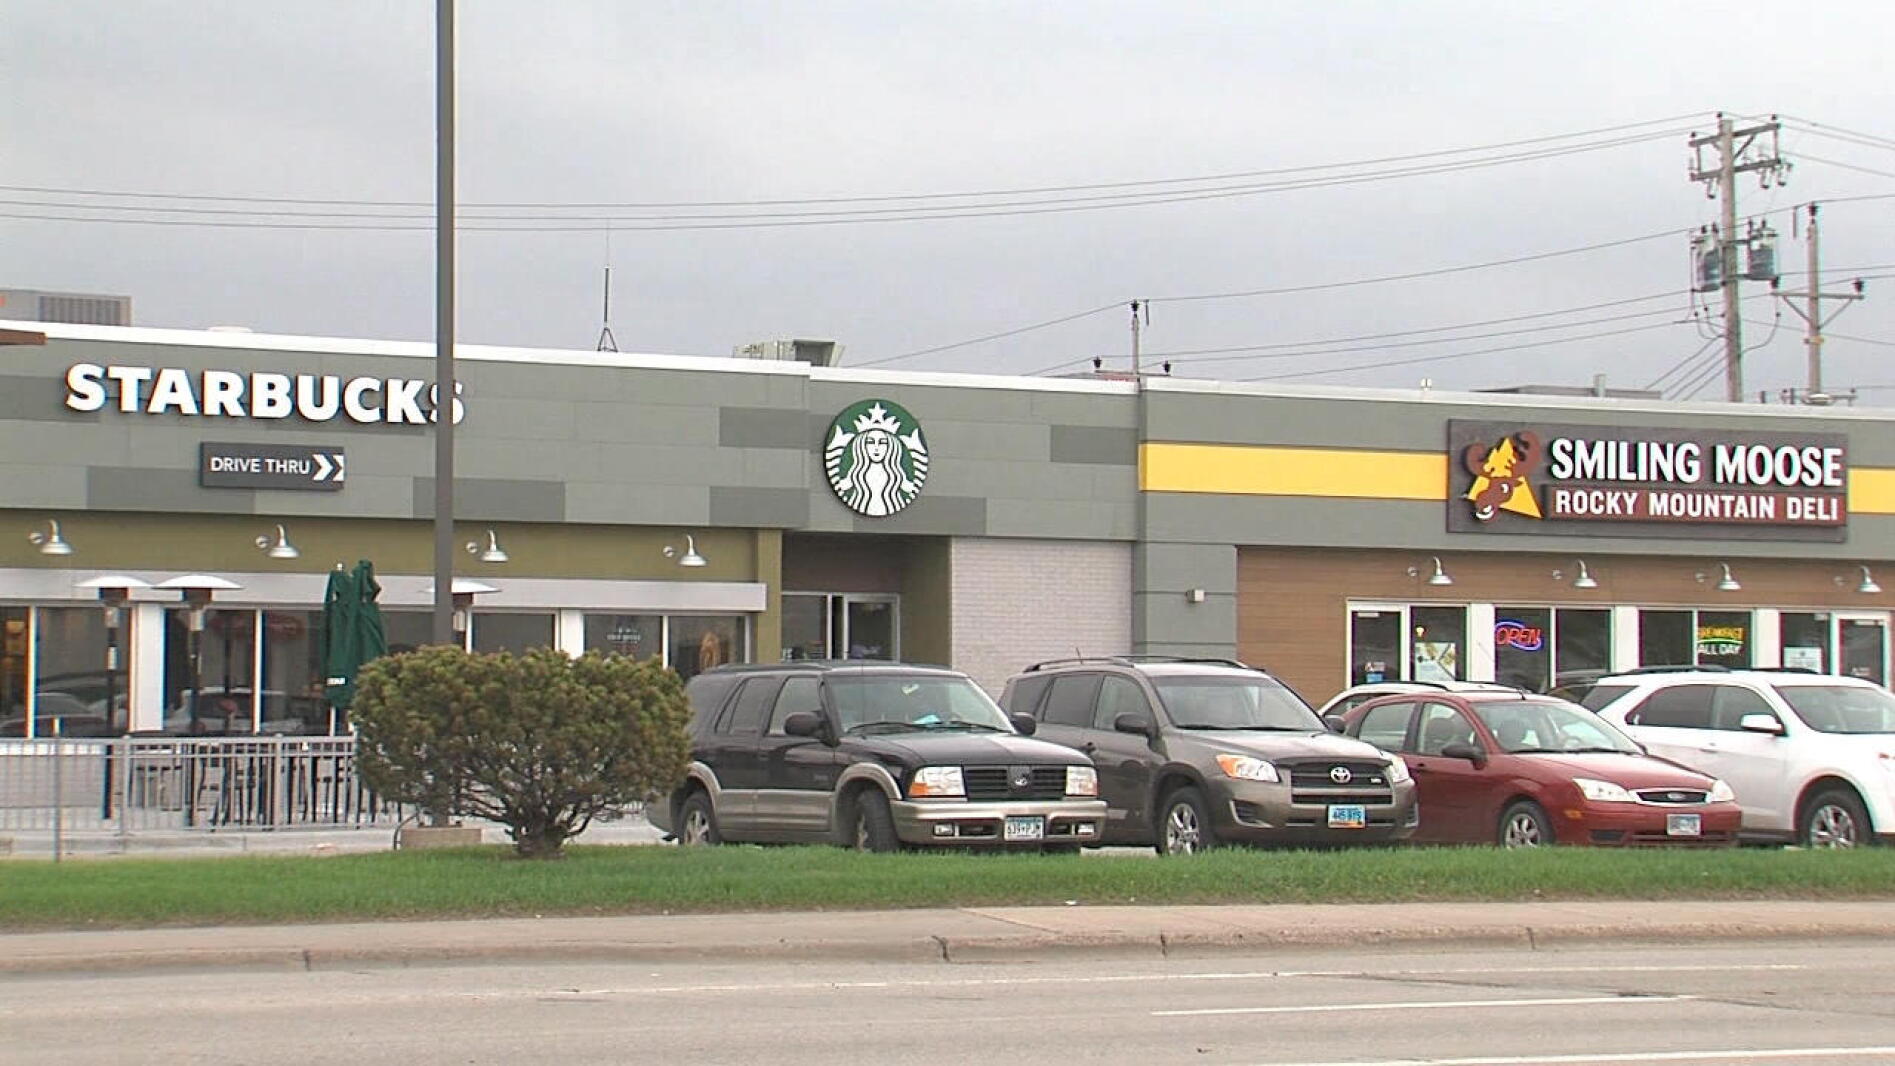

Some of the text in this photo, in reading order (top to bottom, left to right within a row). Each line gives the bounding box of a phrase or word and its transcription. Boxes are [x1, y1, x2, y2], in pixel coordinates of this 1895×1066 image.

[65, 363, 465, 425] STARBUCKS
[210, 456, 311, 475] DRIVE THRU
[1551, 438, 1843, 487] SMILING MOOSE
[1555, 489, 1838, 521] ROCKY MOUNTAIN DELI
[1496, 626, 1542, 646] OPEN
[1697, 643, 1742, 655] ALL DAY
